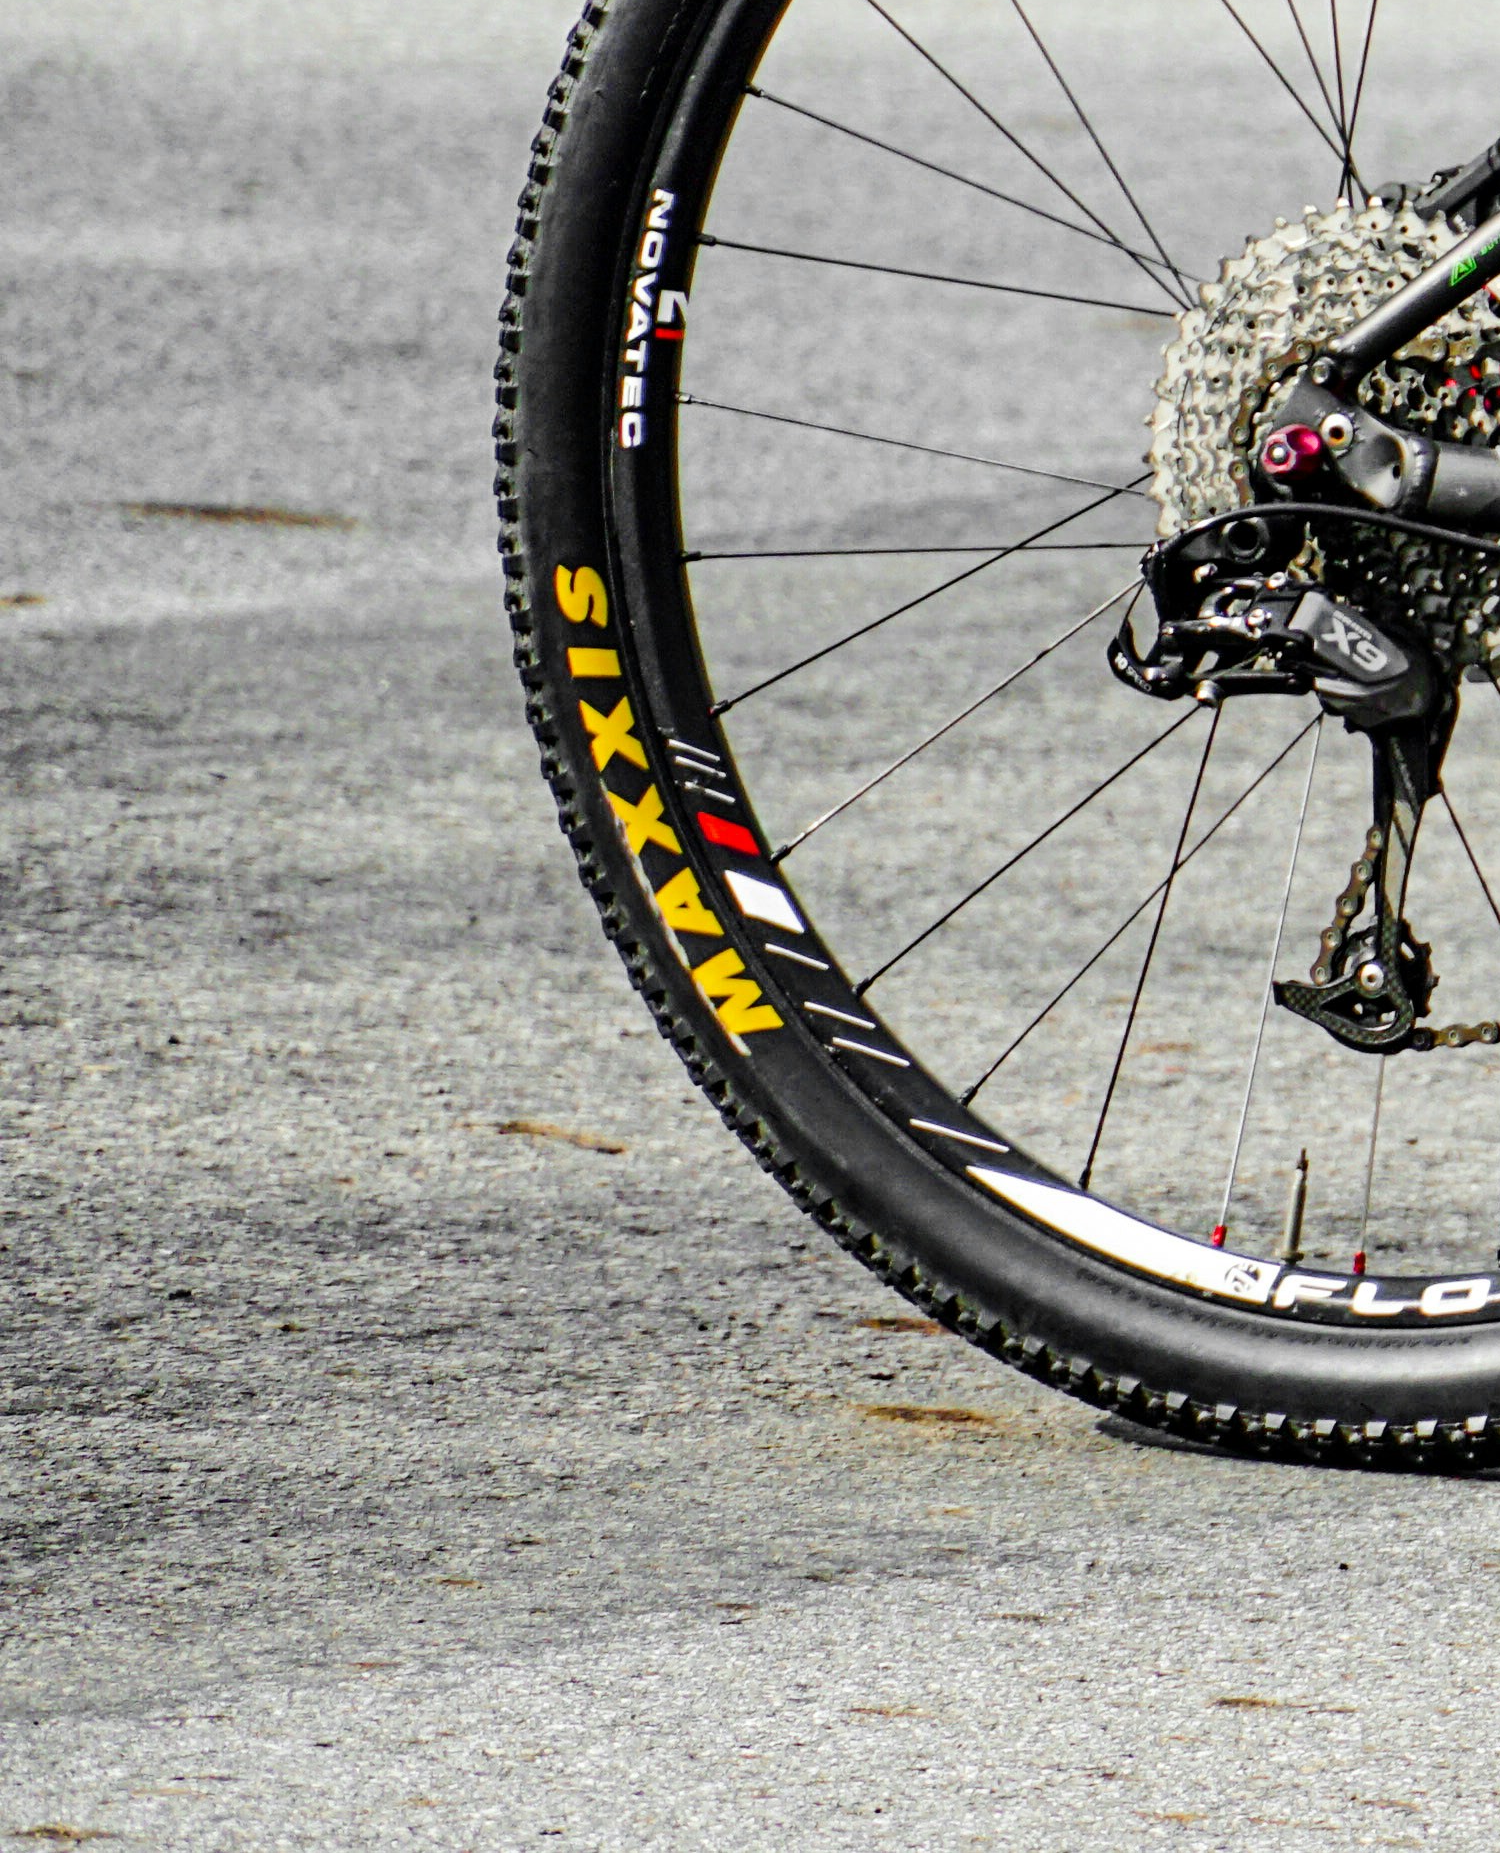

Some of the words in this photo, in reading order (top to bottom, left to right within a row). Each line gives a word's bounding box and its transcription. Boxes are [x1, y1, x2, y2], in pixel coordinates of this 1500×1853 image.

[619, 189, 675, 448] NOVATEC
[1113, 651, 1129, 669] 10
[1325, 618, 1387, 672] X9
[554, 564, 785, 1037] MAXXIS
